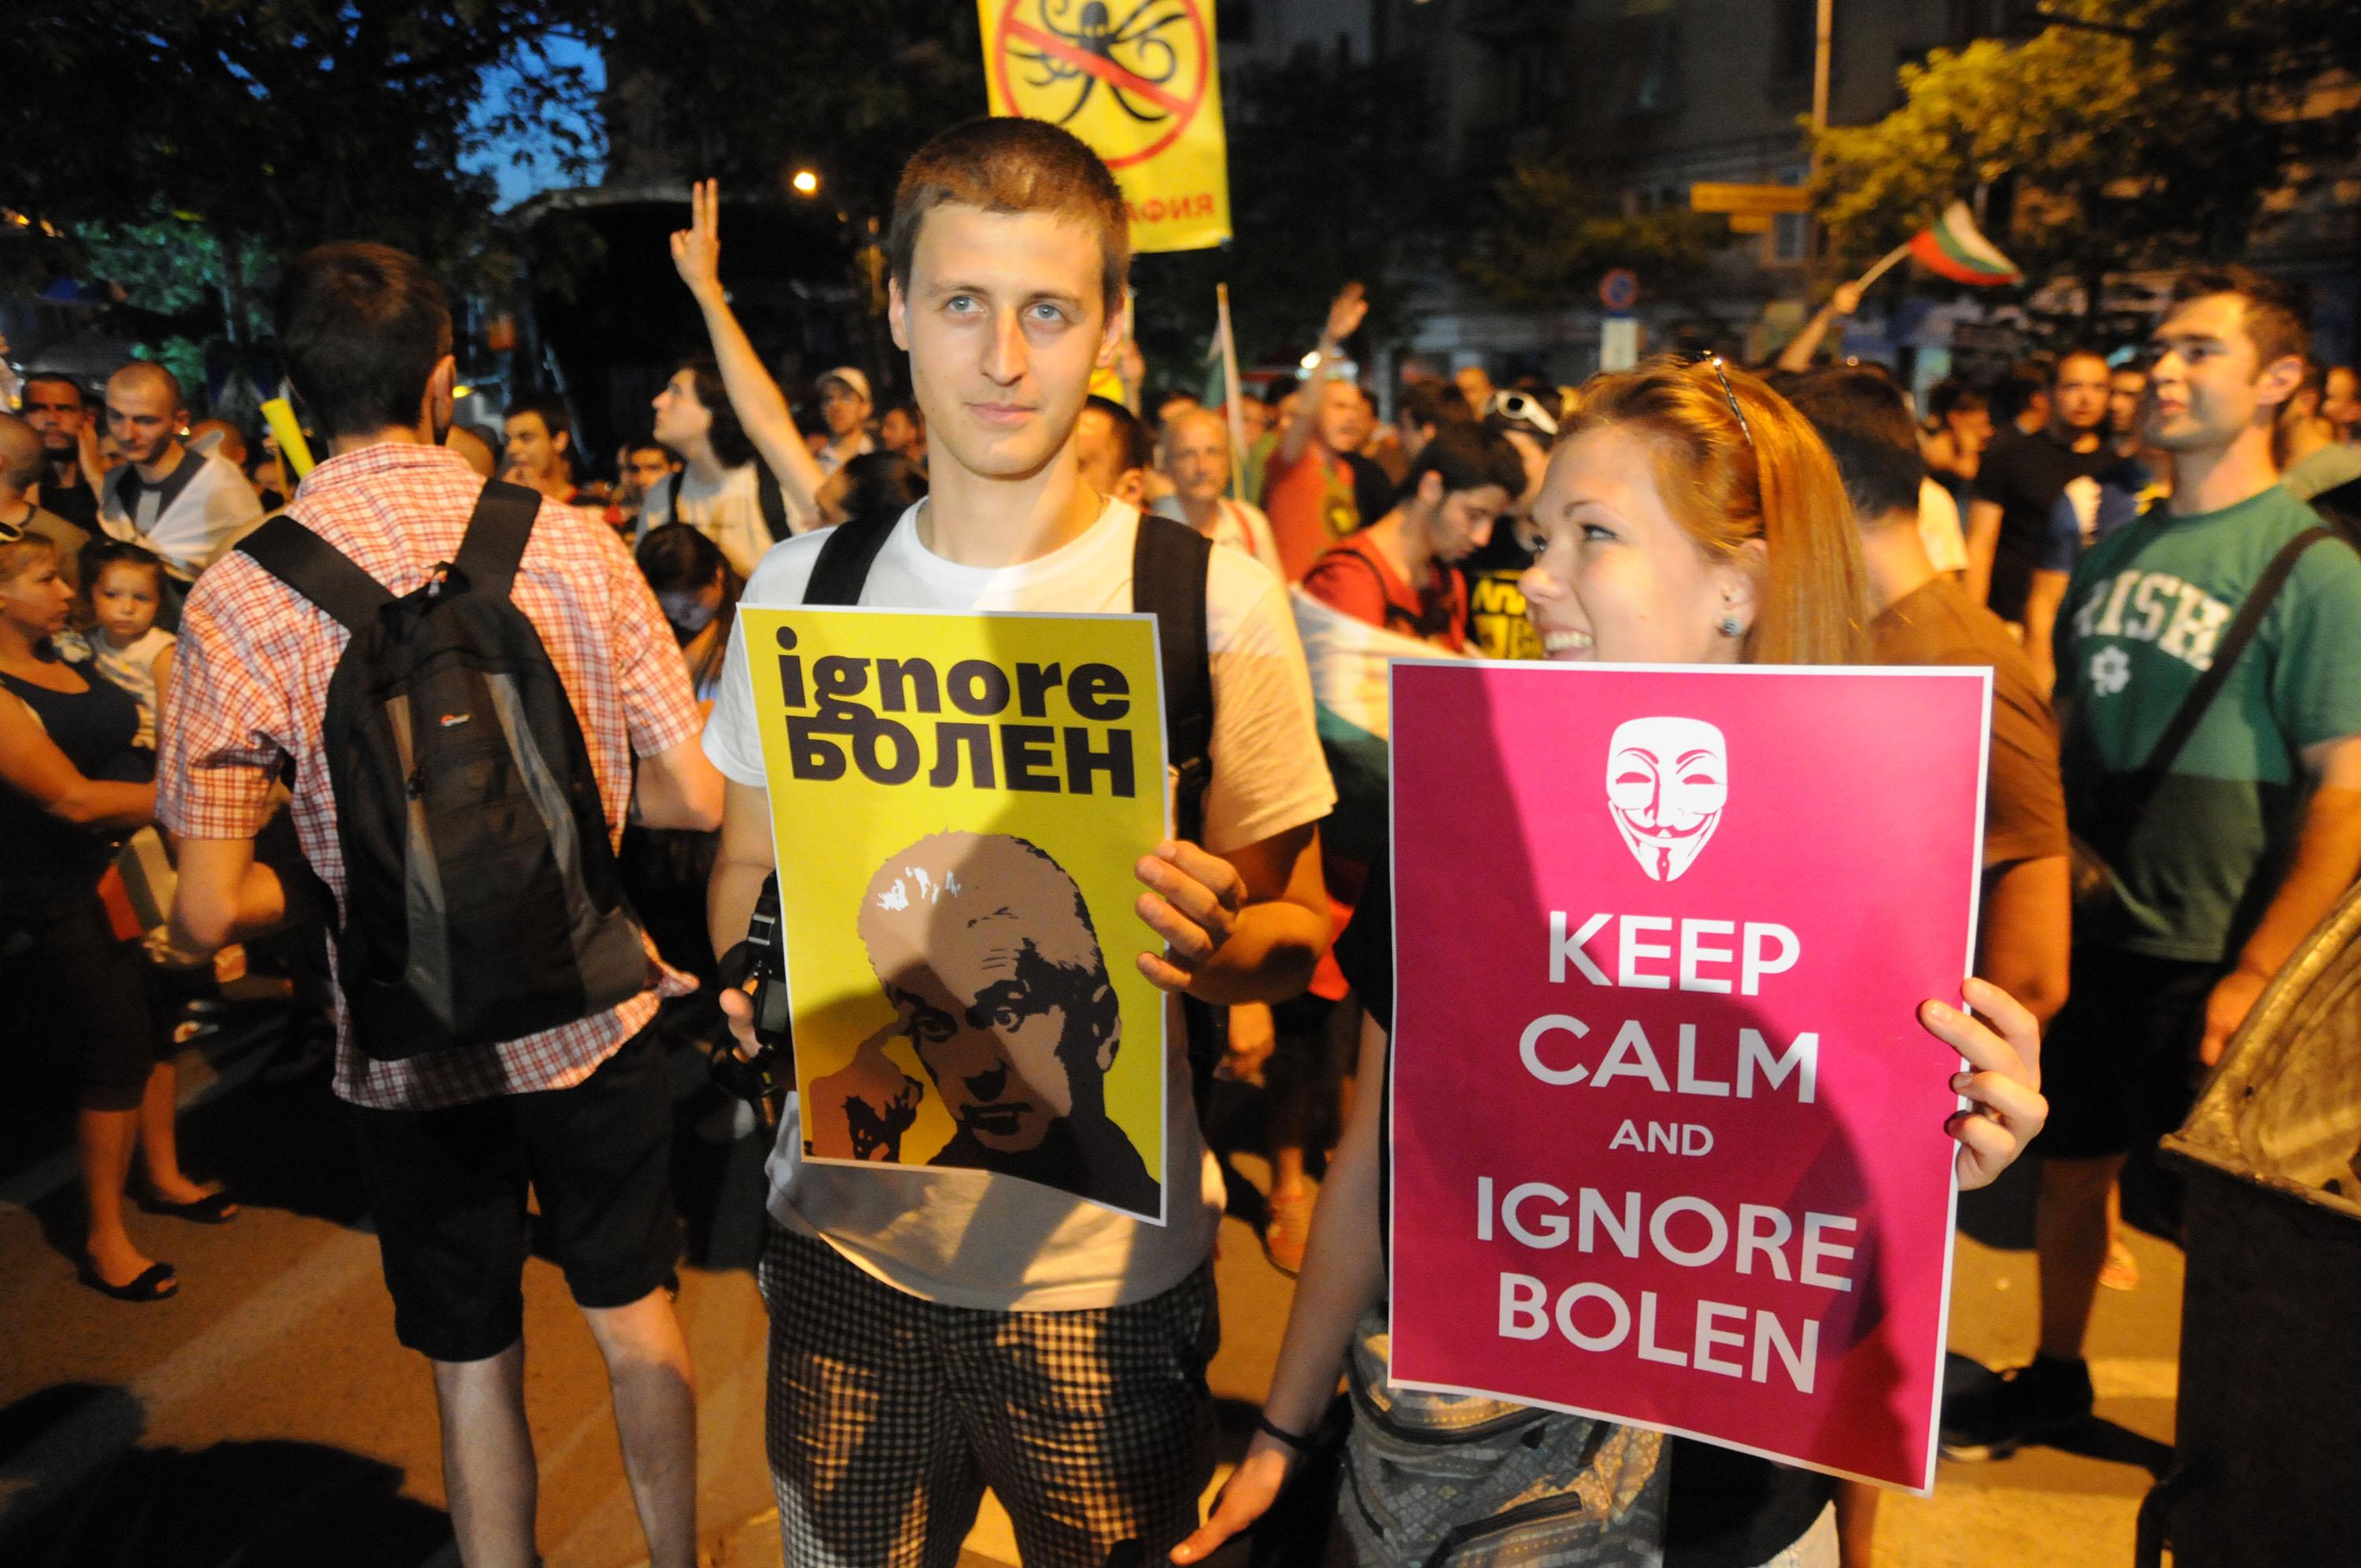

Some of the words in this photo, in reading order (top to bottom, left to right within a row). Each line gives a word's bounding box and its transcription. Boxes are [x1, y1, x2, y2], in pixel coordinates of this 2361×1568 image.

[1124, 194, 1214, 223] АФИЯ
[776, 625, 1130, 725] ignore
[785, 715, 1136, 799] БОЛЕН
[1548, 910, 1801, 996] KEEP
[1519, 1013, 1820, 1104] CALM
[1609, 1119, 1714, 1157] AND
[1477, 1176, 1857, 1293] IGNORE
[1498, 1271, 1820, 1395] BOLEN
